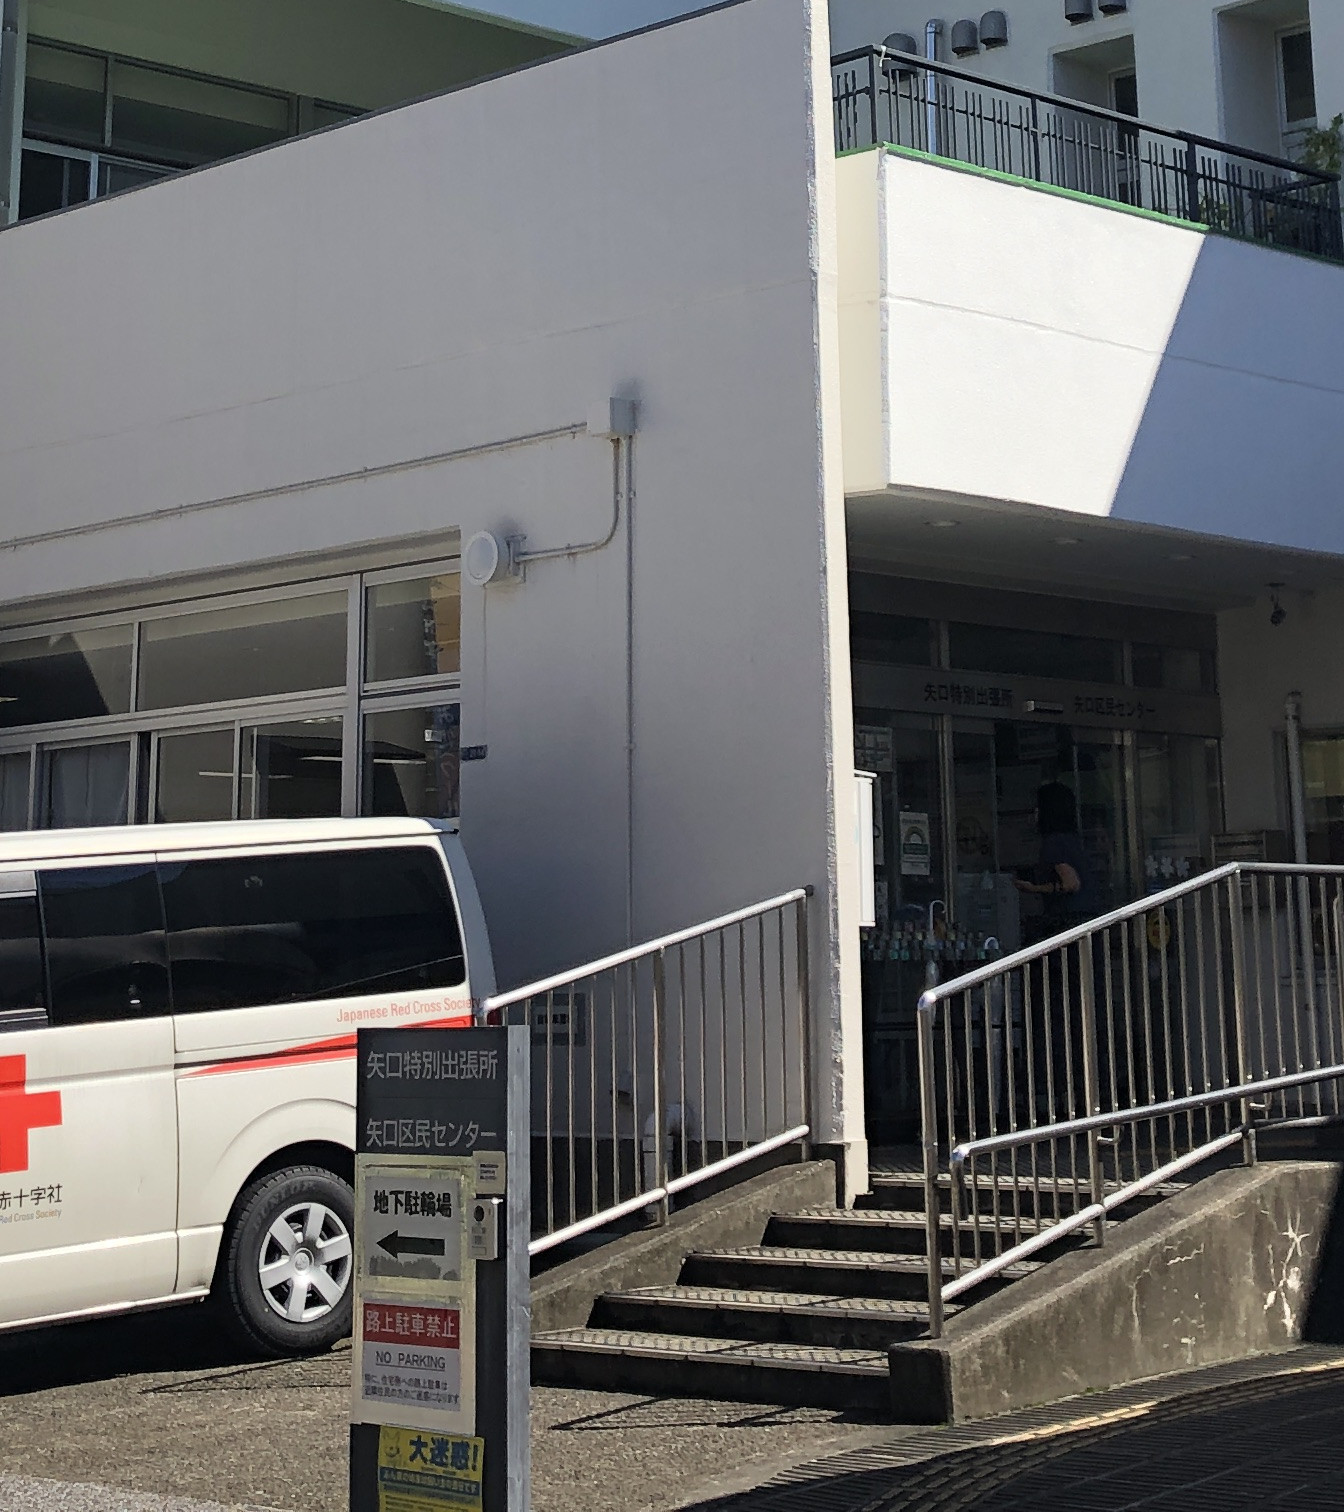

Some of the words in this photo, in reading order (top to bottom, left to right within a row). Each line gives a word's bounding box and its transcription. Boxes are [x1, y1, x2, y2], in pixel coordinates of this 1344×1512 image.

[336, 1006, 388, 1023] Japanese
[391, 1002, 411, 1017] Red
[413, 1000, 442, 1015] Cross
[366, 1050, 498, 1080] 矢口特別出張所
[366, 1118, 497, 1148] 矢口区民センター
[14, 1212, 34, 1223] Cross
[35, 1208, 62, 1220] Society
[373, 1189, 453, 1218] 地下駐輪場
[365, 1309, 457, 1338] 路上駐車禁止
[376, 1351, 392, 1364] NO
[398, 1352, 446, 1369] PARKING
